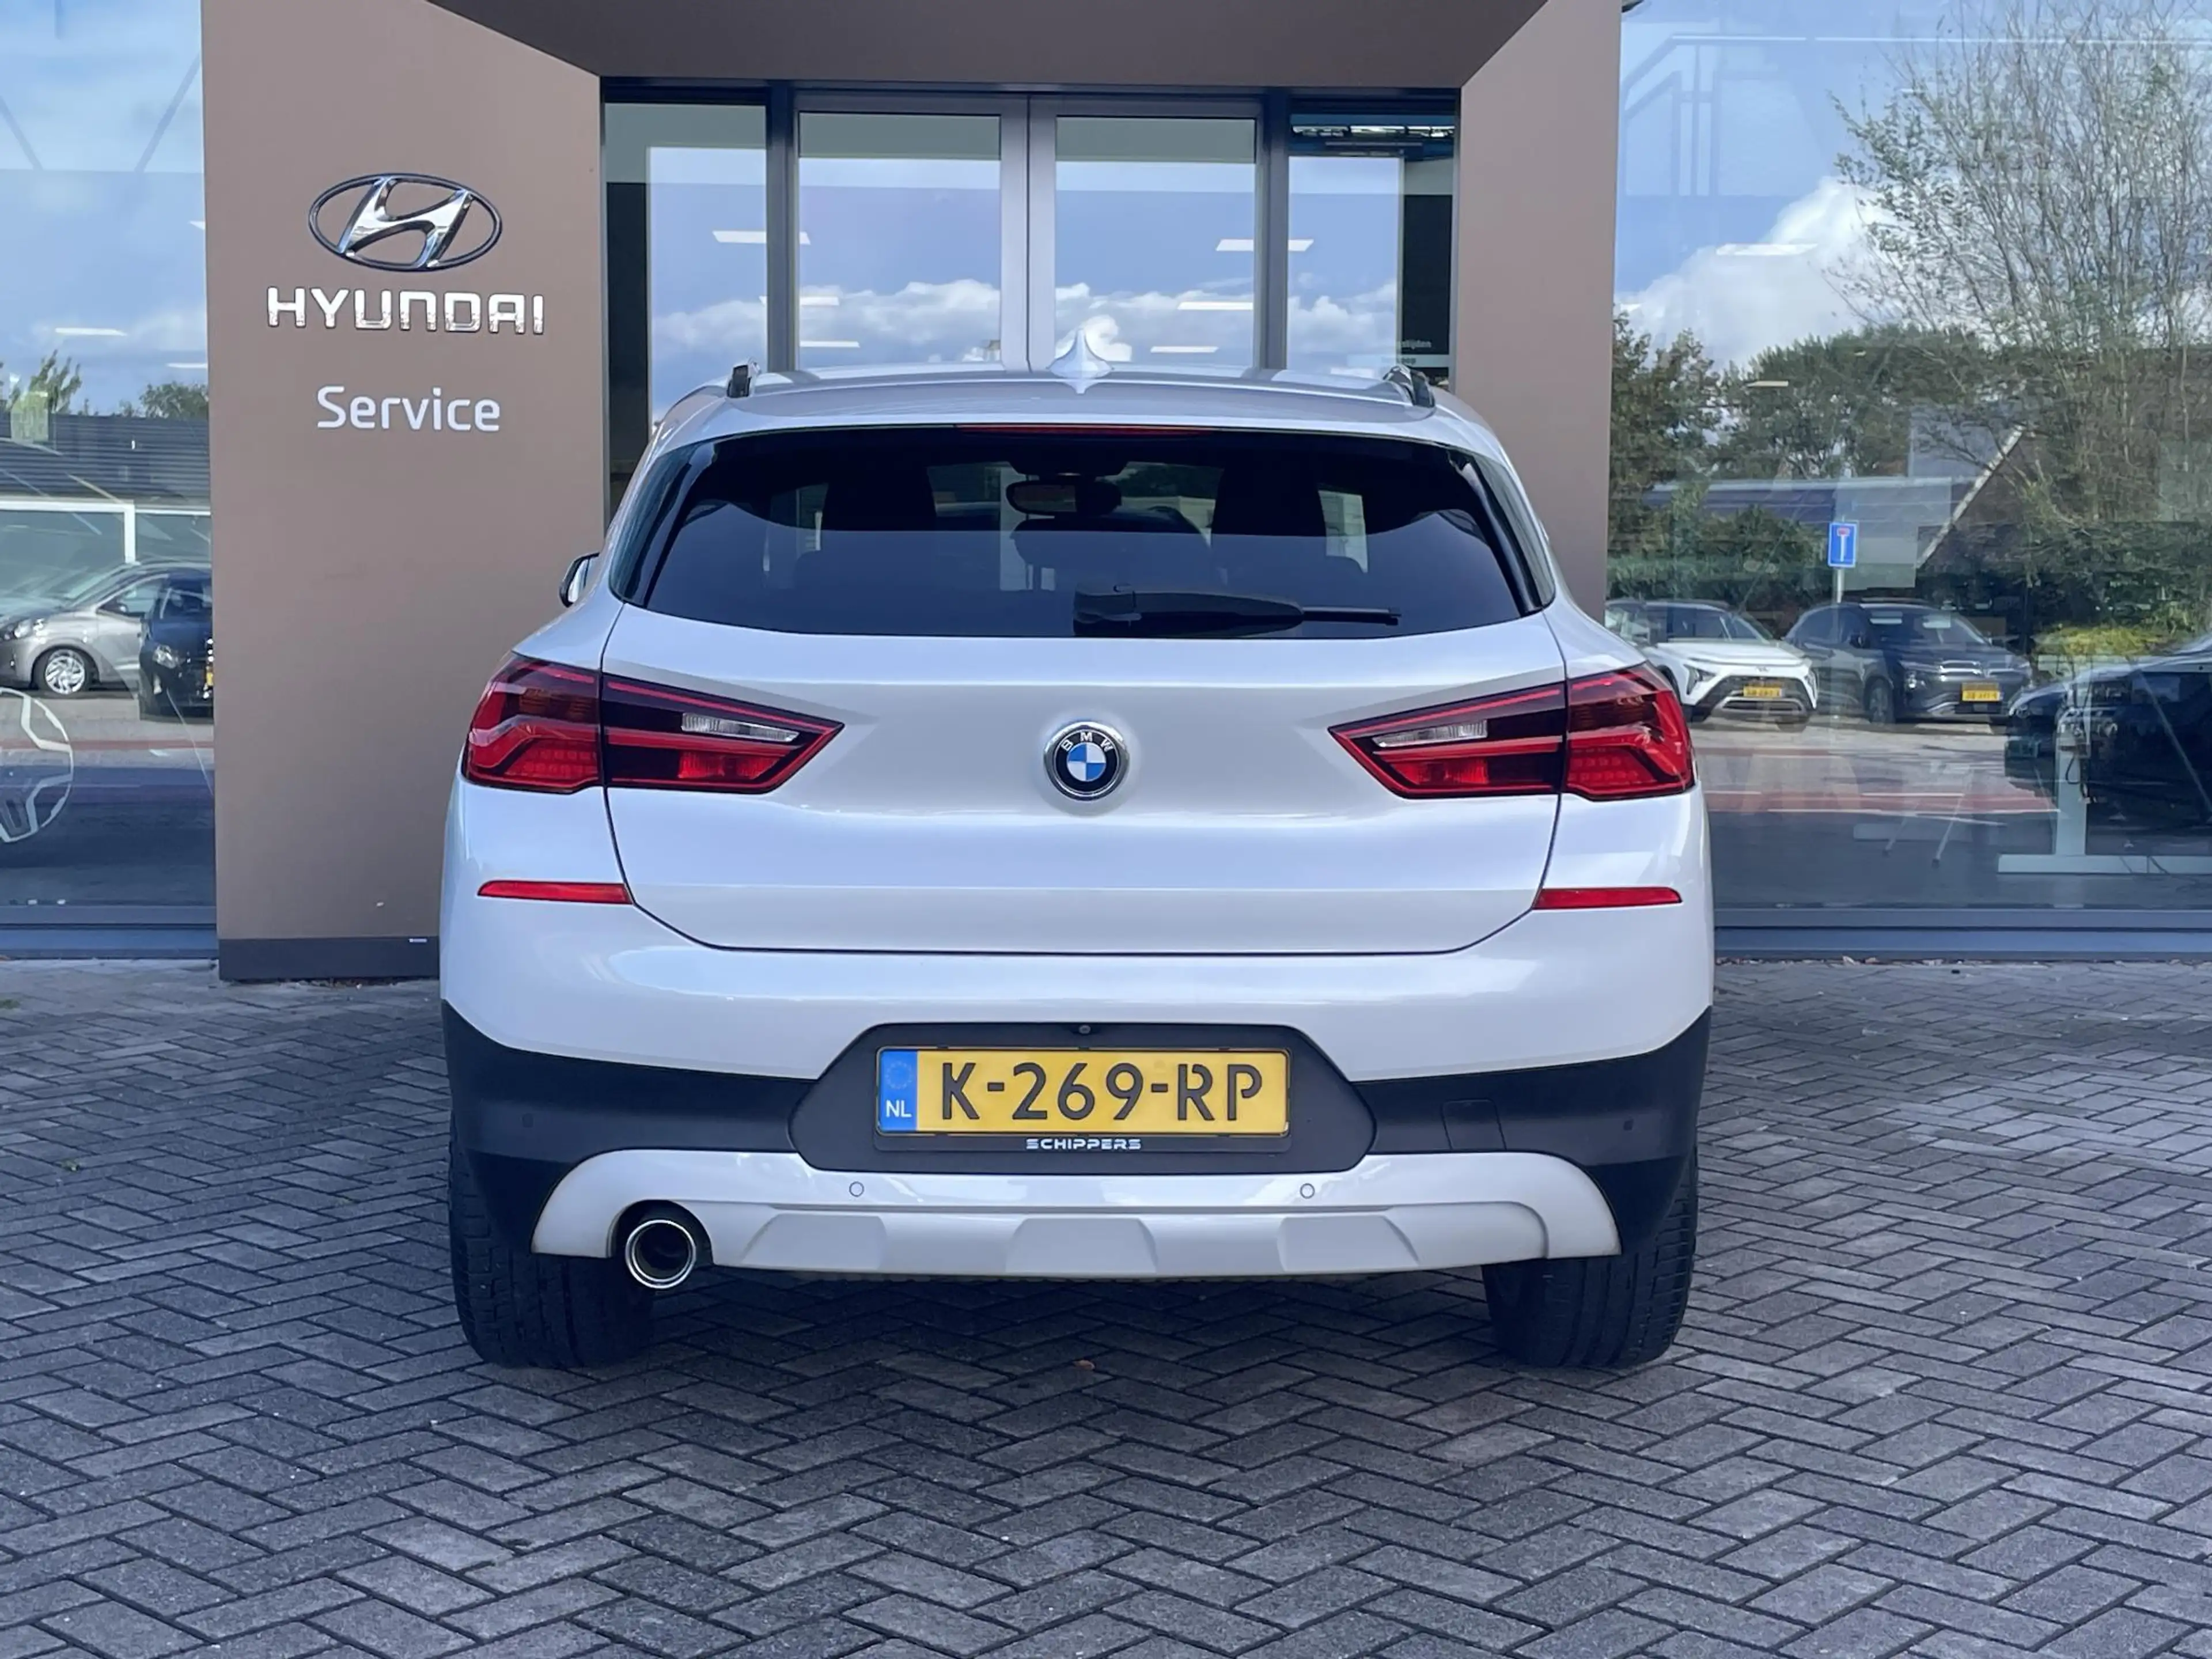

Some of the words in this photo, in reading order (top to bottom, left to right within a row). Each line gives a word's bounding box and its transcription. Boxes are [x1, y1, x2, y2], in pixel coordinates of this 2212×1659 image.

[267, 287, 544, 335] HYUNDAI
[317, 385, 500, 431] Service
[1060, 732, 1113, 752] BMW
[942, 1062, 1262, 1120] K-269-RP
[885, 1100, 912, 1118] NL
[1026, 1138, 1141, 1150] SCHIPPERS
